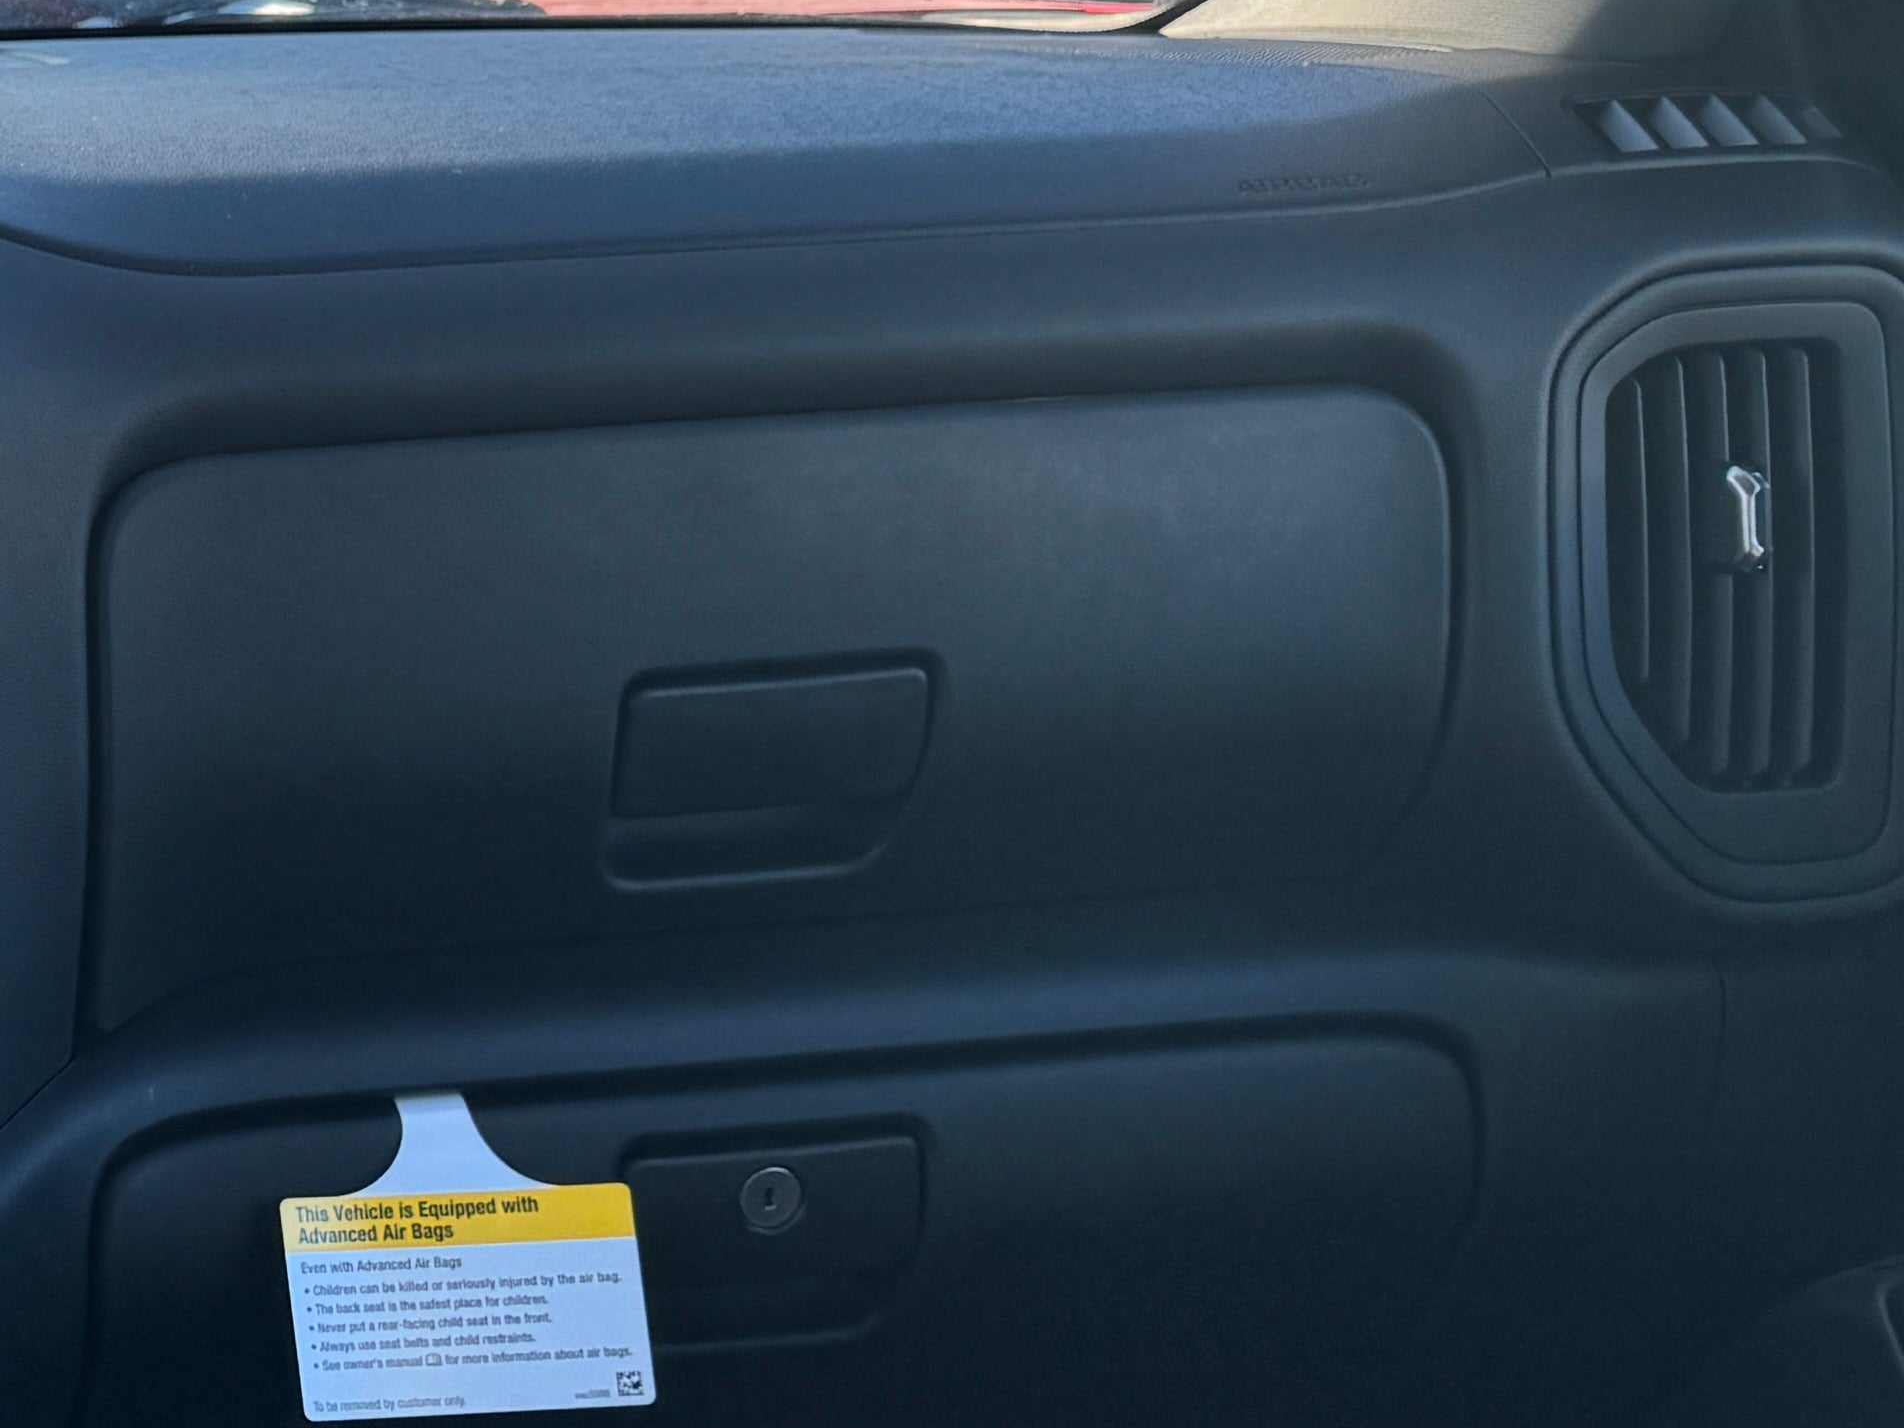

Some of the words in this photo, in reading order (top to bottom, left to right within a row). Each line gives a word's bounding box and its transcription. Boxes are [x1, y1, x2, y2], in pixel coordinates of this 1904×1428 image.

[296, 1205, 330, 1224] This
[333, 1201, 395, 1222] Vehicle
[399, 1200, 414, 1219] is
[418, 1198, 497, 1222] Equipped
[501, 1196, 539, 1215] with
[298, 1225, 378, 1245] Advanced
[383, 1224, 407, 1242] Air
[411, 1222, 455, 1243] Bags
[300, 1261, 328, 1275] Even
[330, 1260, 354, 1274] with
[357, 1257, 412, 1273] Advanced
[415, 1256, 431, 1270] Air
[433, 1255, 463, 1270] Bags
[312, 1283, 357, 1297] Children
[359, 1283, 380, 1294] can
[382, 1281, 396, 1293] be
[398, 1280, 429, 1293] killed
[432, 1281, 443, 1291] or
[446, 1277, 496, 1292] seriously
[499, 1275, 538, 1290] injured
[541, 1274, 554, 1288] by
[557, 1273, 576, 1285] the
[579, 1272, 594, 1284] air
[597, 1271, 622, 1284] bag.
[315, 1303, 334, 1315] The
[336, 1301, 361, 1314] back
[363, 1301, 386, 1313] seat
[388, 1301, 397, 1312] is
[400, 1299, 417, 1312] the
[419, 1298, 451, 1311] safest
[454, 1297, 483, 1311] place
[485, 1296, 499, 1308] for
[318, 1321, 346, 1334] Never
[349, 1320, 366, 1335] put
[368, 1322, 376, 1332] a
[378, 1317, 436, 1332] rear-facing
[438, 1316, 464, 1329] child
[466, 1315, 489, 1327] seat
[491, 1314, 502, 1325] in
[504, 1313, 522, 1325] the
[319, 1341, 356, 1354] Always
[358, 1339, 377, 1351] use
[379, 1338, 402, 1350] seat
[403, 1337, 430, 1349] belts
[432, 1335, 452, 1347] and
[454, 1334, 480, 1346] child
[343, 1357, 384, 1371] owner's
[385, 1355, 423, 1369] manual
[444, 1354, 459, 1365] for
[461, 1353, 489, 1365] more
[491, 1350, 552, 1364] information
[554, 1348, 584, 1360] about
[587, 1347, 601, 1359] air
